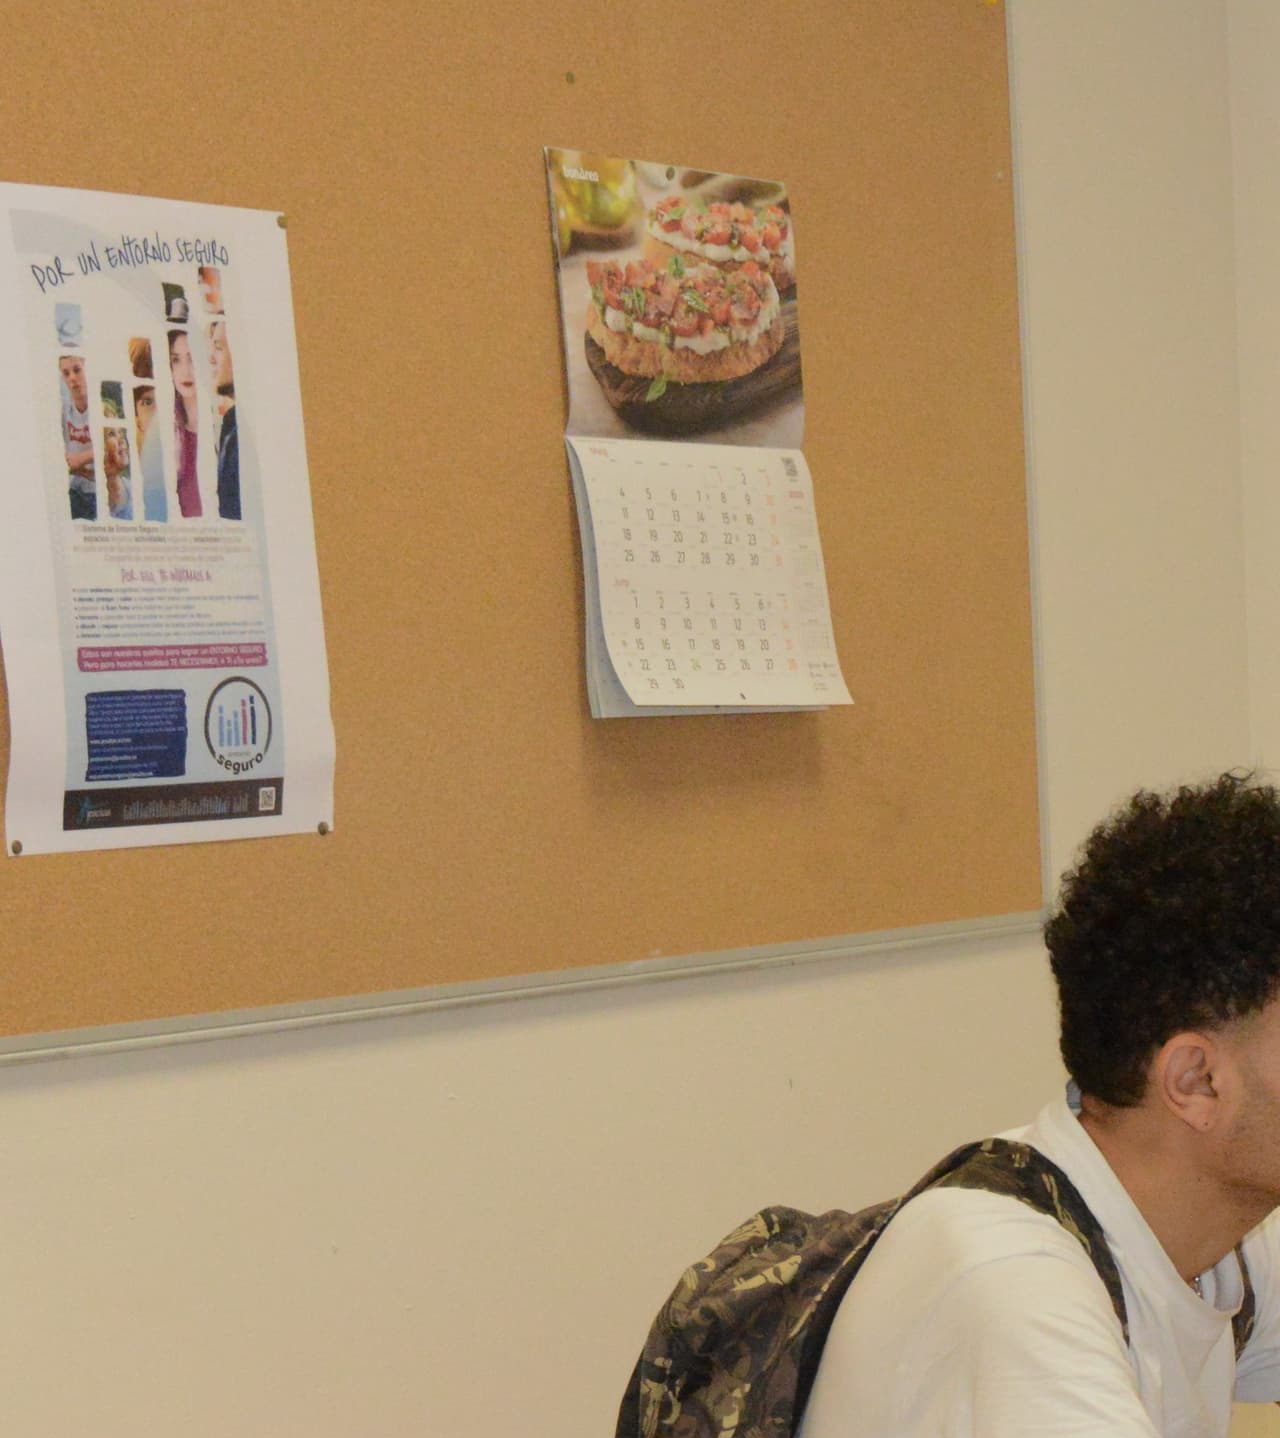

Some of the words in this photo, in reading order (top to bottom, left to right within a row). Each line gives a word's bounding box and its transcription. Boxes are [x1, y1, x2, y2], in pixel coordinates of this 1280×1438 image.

[32, 256, 75, 293] POR
[78, 241, 102, 277] UN
[105, 232, 172, 268] ENTORNO
[176, 237, 230, 267] SEGURO
[645, 487, 652, 500] 5
[670, 489, 678, 502] 6
[217, 752, 263, 775] seguro
